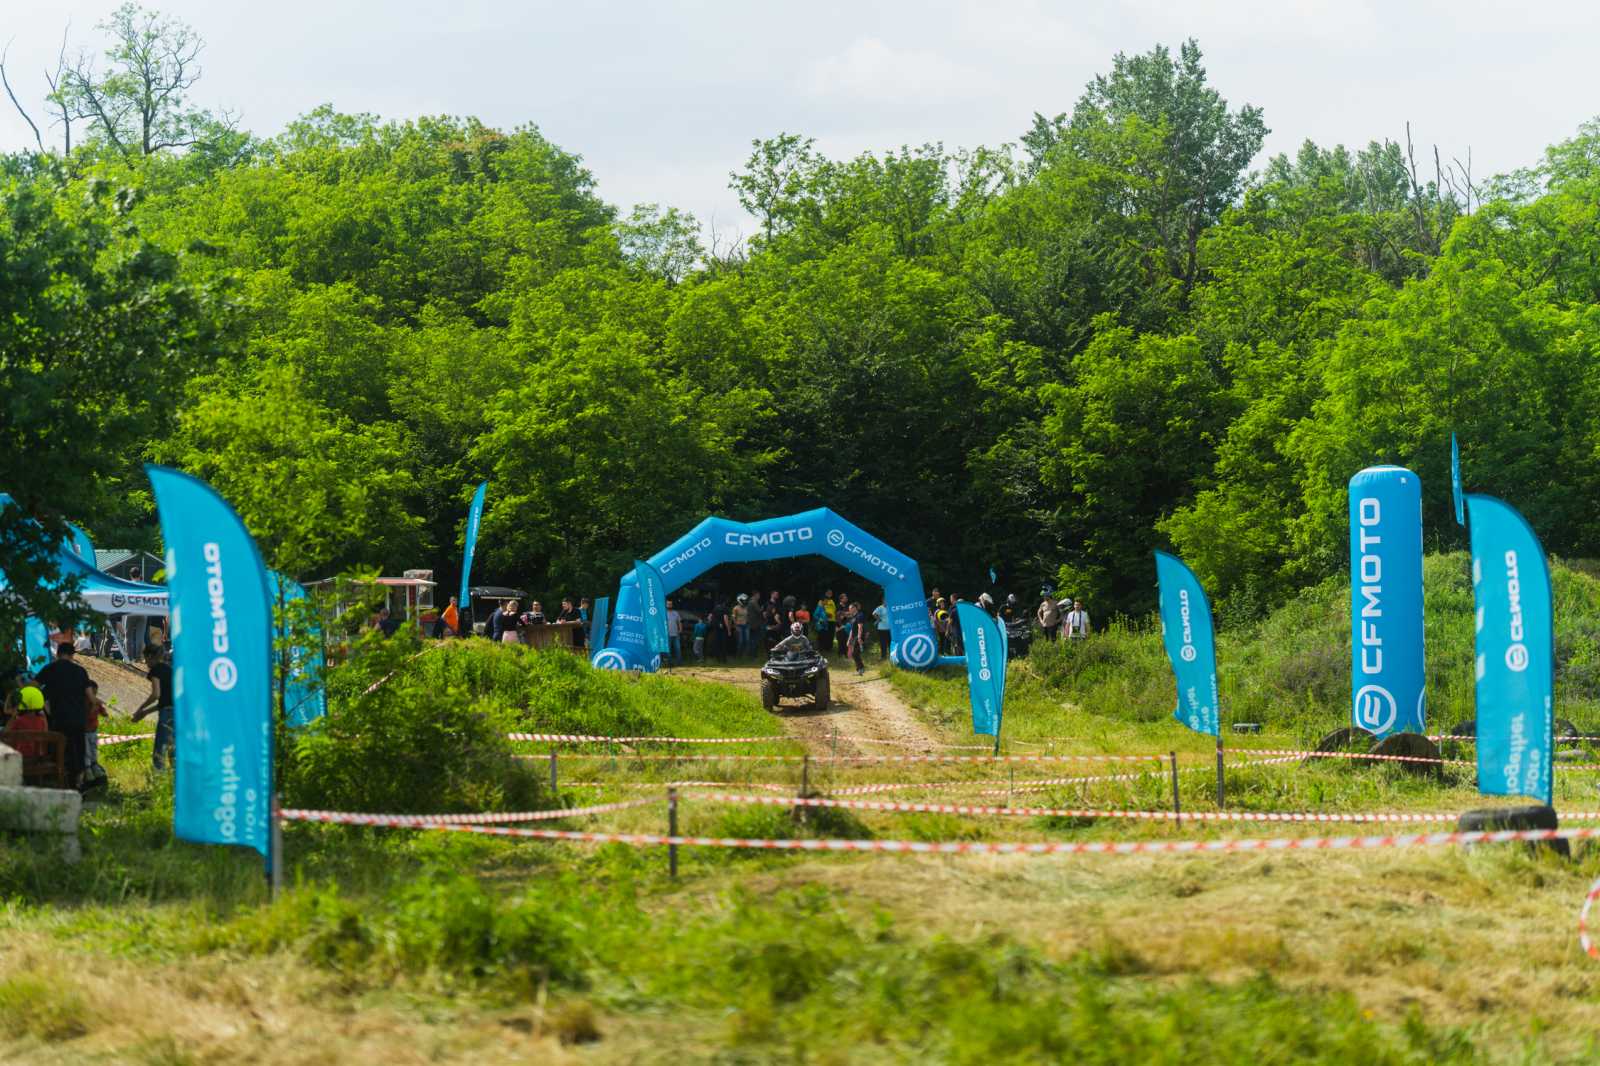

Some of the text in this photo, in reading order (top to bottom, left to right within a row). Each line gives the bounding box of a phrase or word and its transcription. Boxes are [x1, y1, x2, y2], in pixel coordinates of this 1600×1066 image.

[725, 527, 812, 547] CFMOTO
[660, 537, 711, 574] CFMOTO
[844, 541, 897, 576] CFMOTO
[128, 596, 167, 606] CFMOT
[1360, 498, 1382, 674] CFMOTO
